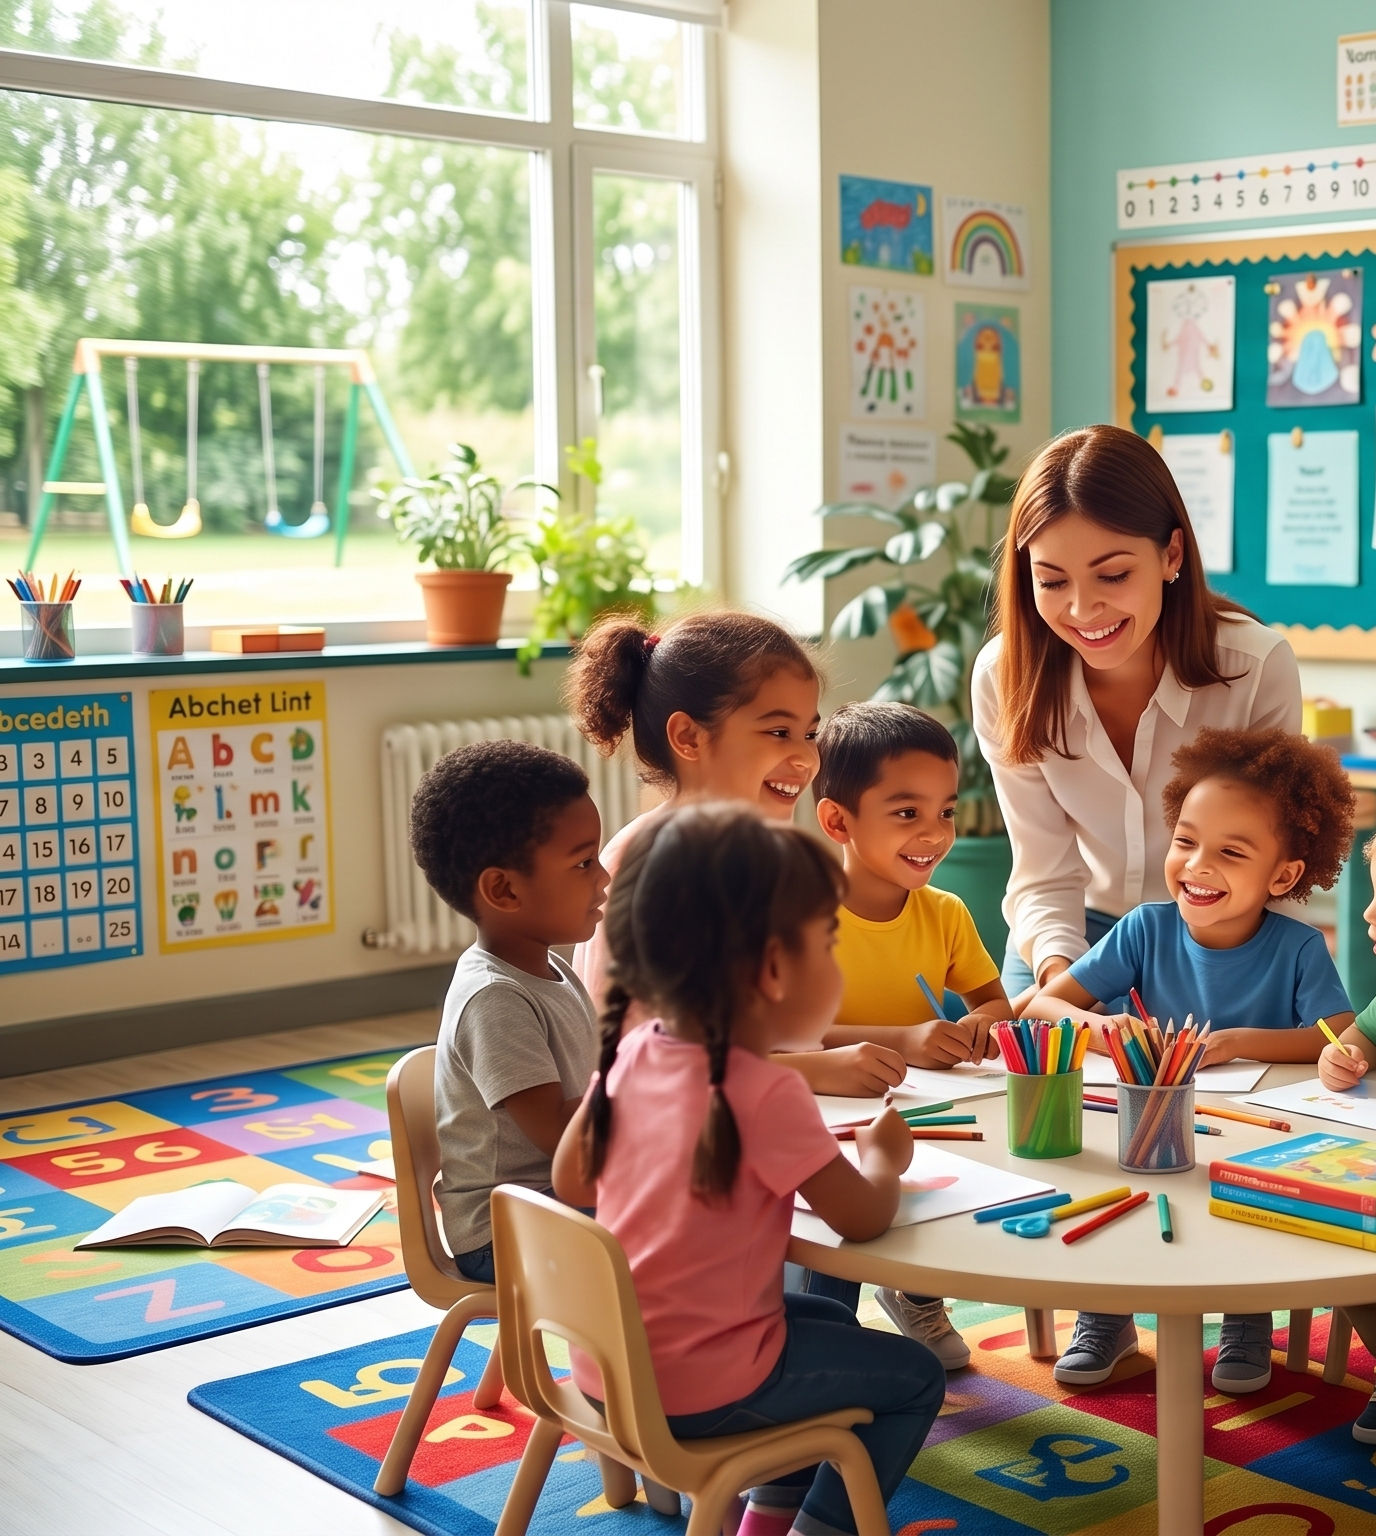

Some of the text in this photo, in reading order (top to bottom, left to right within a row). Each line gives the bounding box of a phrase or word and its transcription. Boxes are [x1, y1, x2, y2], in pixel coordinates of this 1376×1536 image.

[1125, 201, 1135, 217] 0
[1148, 198, 1154, 216] 1
[1170, 196, 1178, 213] 2
[1192, 195, 1199, 211] 3
[1214, 194, 1222, 207] 4
[1237, 190, 1244, 207] 5
[1259, 189, 1269, 205] 6
[1284, 185, 1291, 200] 7
[1307, 184, 1316, 201] 8
[1331, 181, 1339, 196] 9
[1353, 179, 1369, 196] 10
[169, 691, 311, 718] Abchet Lint
[34, 753, 45, 769] 3
[71, 750, 82, 766] 4
[107, 748, 116, 764] 5
[168, 737, 194, 770] A
[212, 734, 233, 767] b
[36, 797, 47, 814] 8
[73, 794, 83, 810] 9
[104, 791, 123, 807] 10
[250, 792, 279, 815] m
[33, 841, 52, 858] 15
[70, 838, 90, 855] 16
[107, 835, 125, 851] 17
[35, 885, 55, 903] 18
[72, 881, 91, 898] 19
[107, 878, 130, 894] 20
[110, 922, 130, 937] 25
